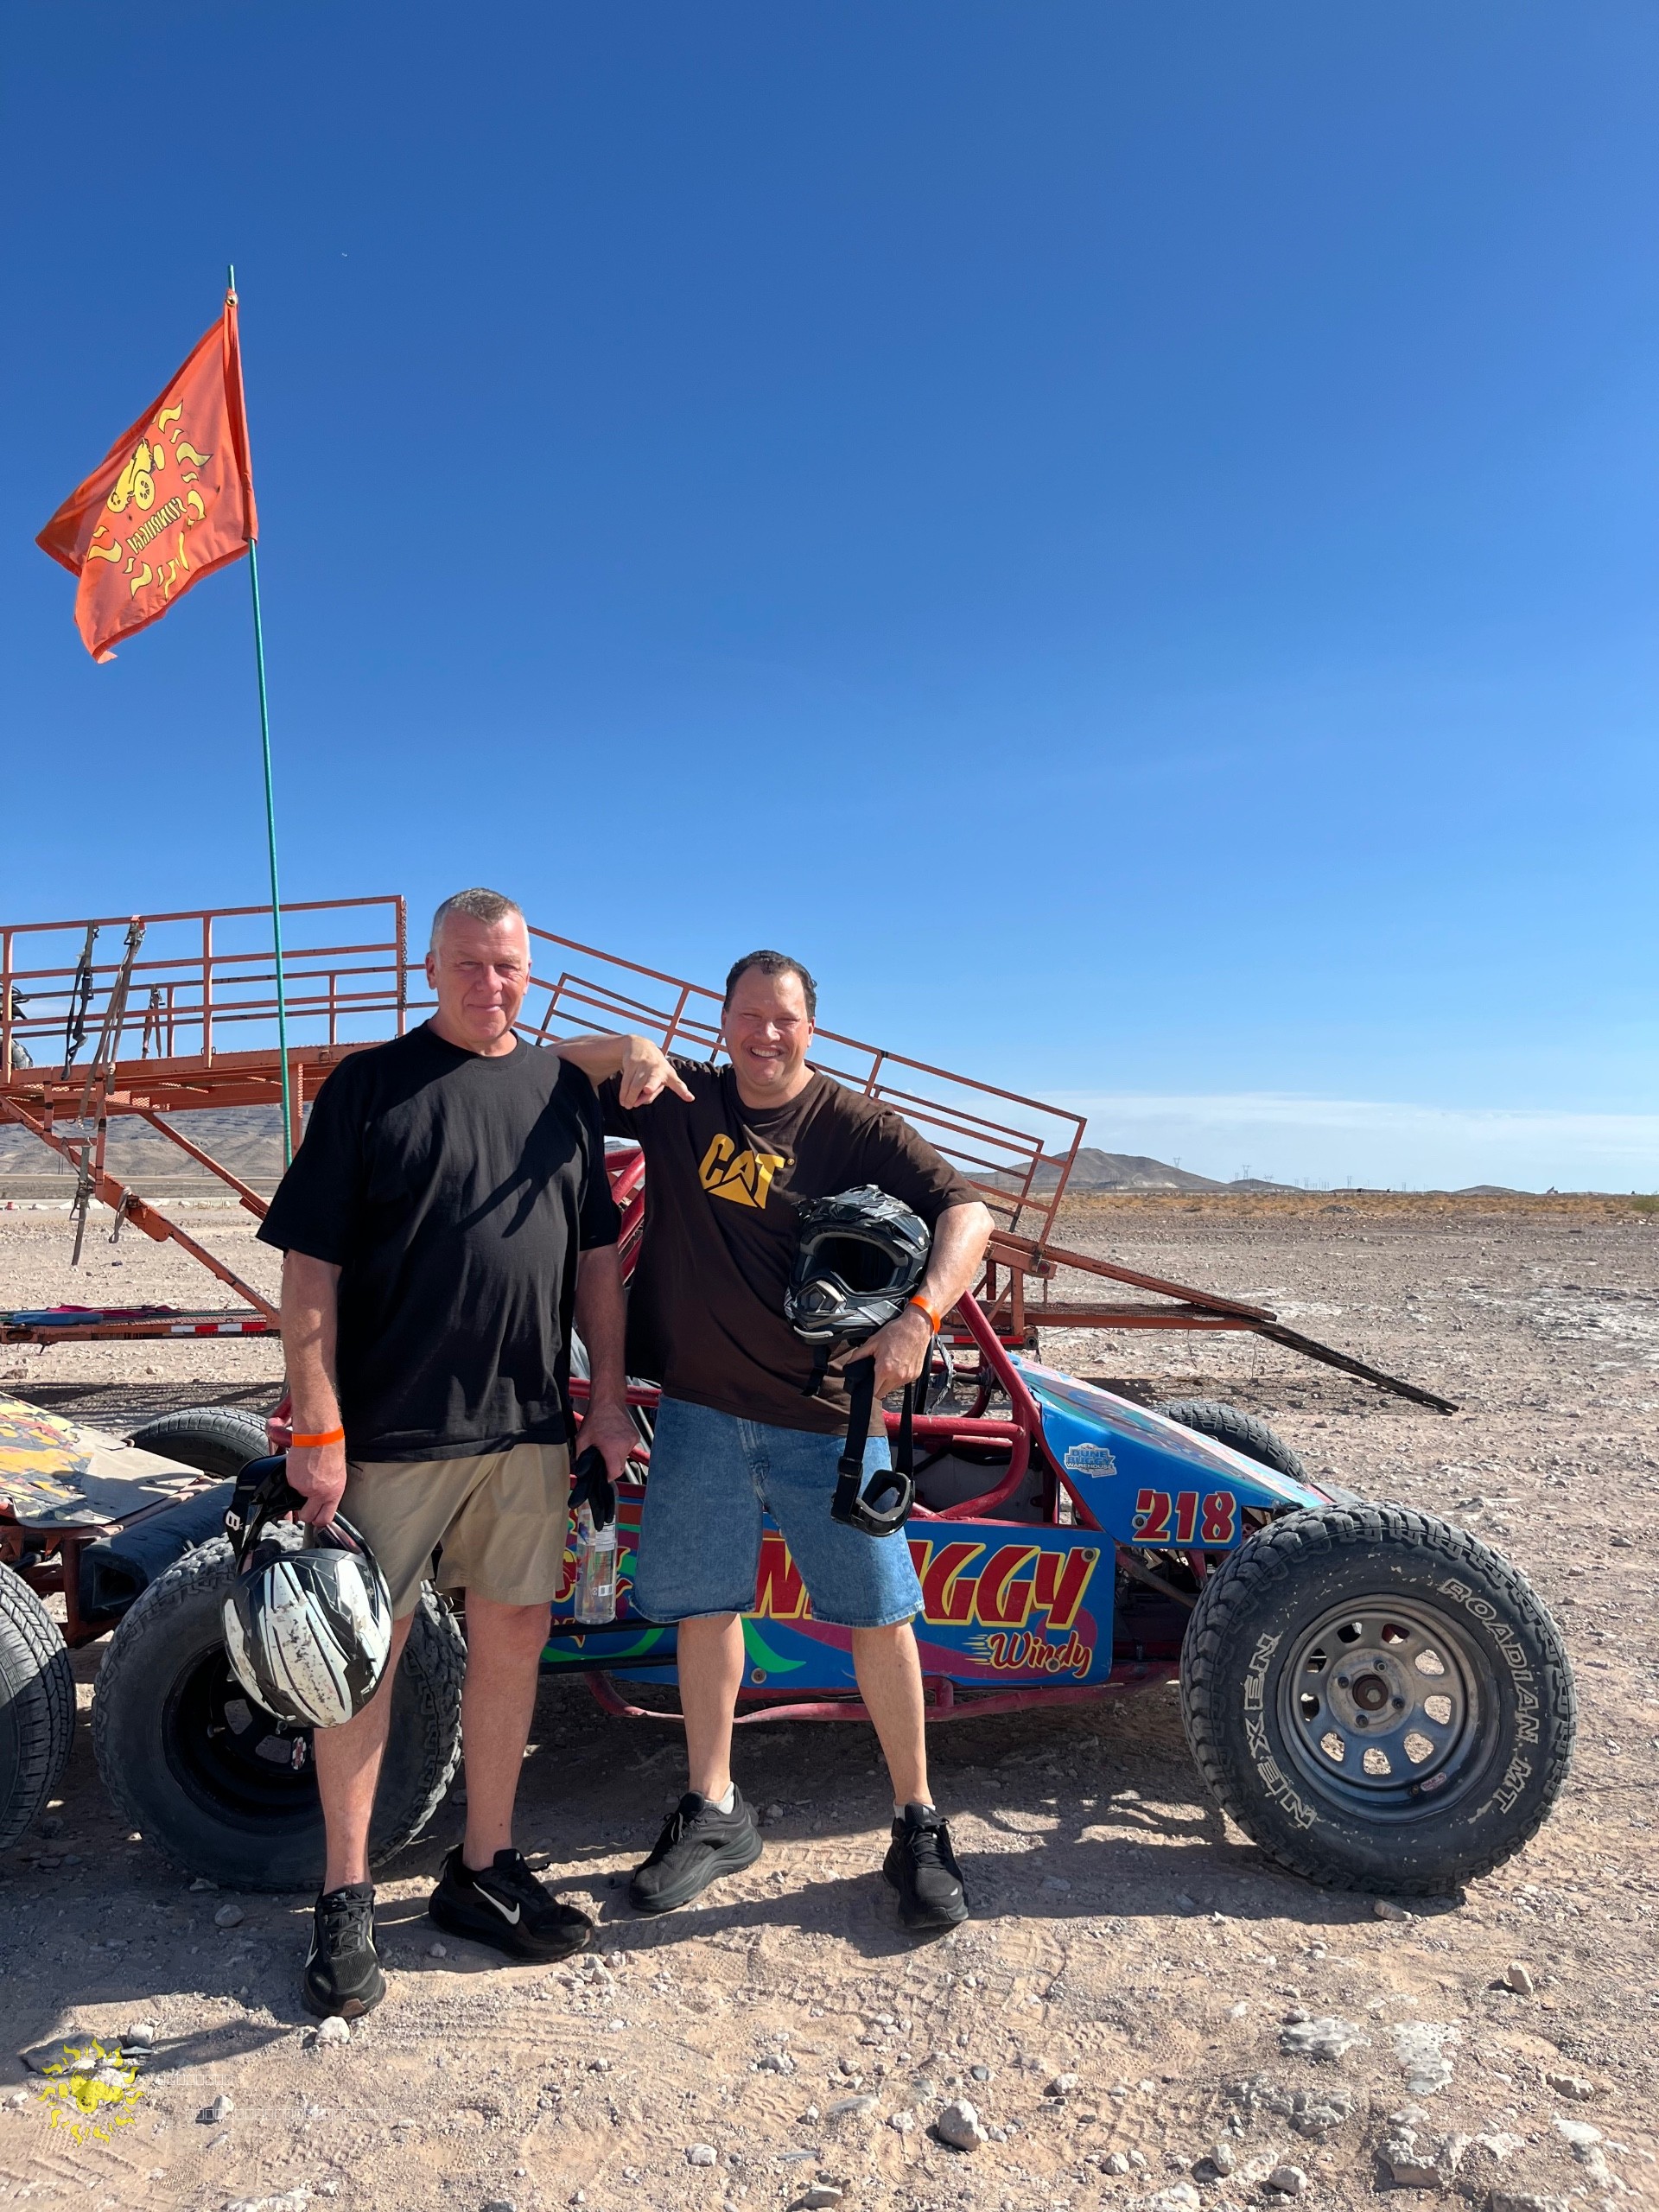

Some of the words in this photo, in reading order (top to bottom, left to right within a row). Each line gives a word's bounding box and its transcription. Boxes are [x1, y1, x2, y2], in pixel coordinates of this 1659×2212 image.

[698, 1133, 785, 1210] CAT
[1132, 1489, 1236, 1542] 218
[987, 1630, 1093, 1679] Windy
[1244, 1632, 1318, 1829] NEXEN
[1438, 1578, 1540, 1744] ROADIAN
[1492, 1756, 1533, 1815] MT
